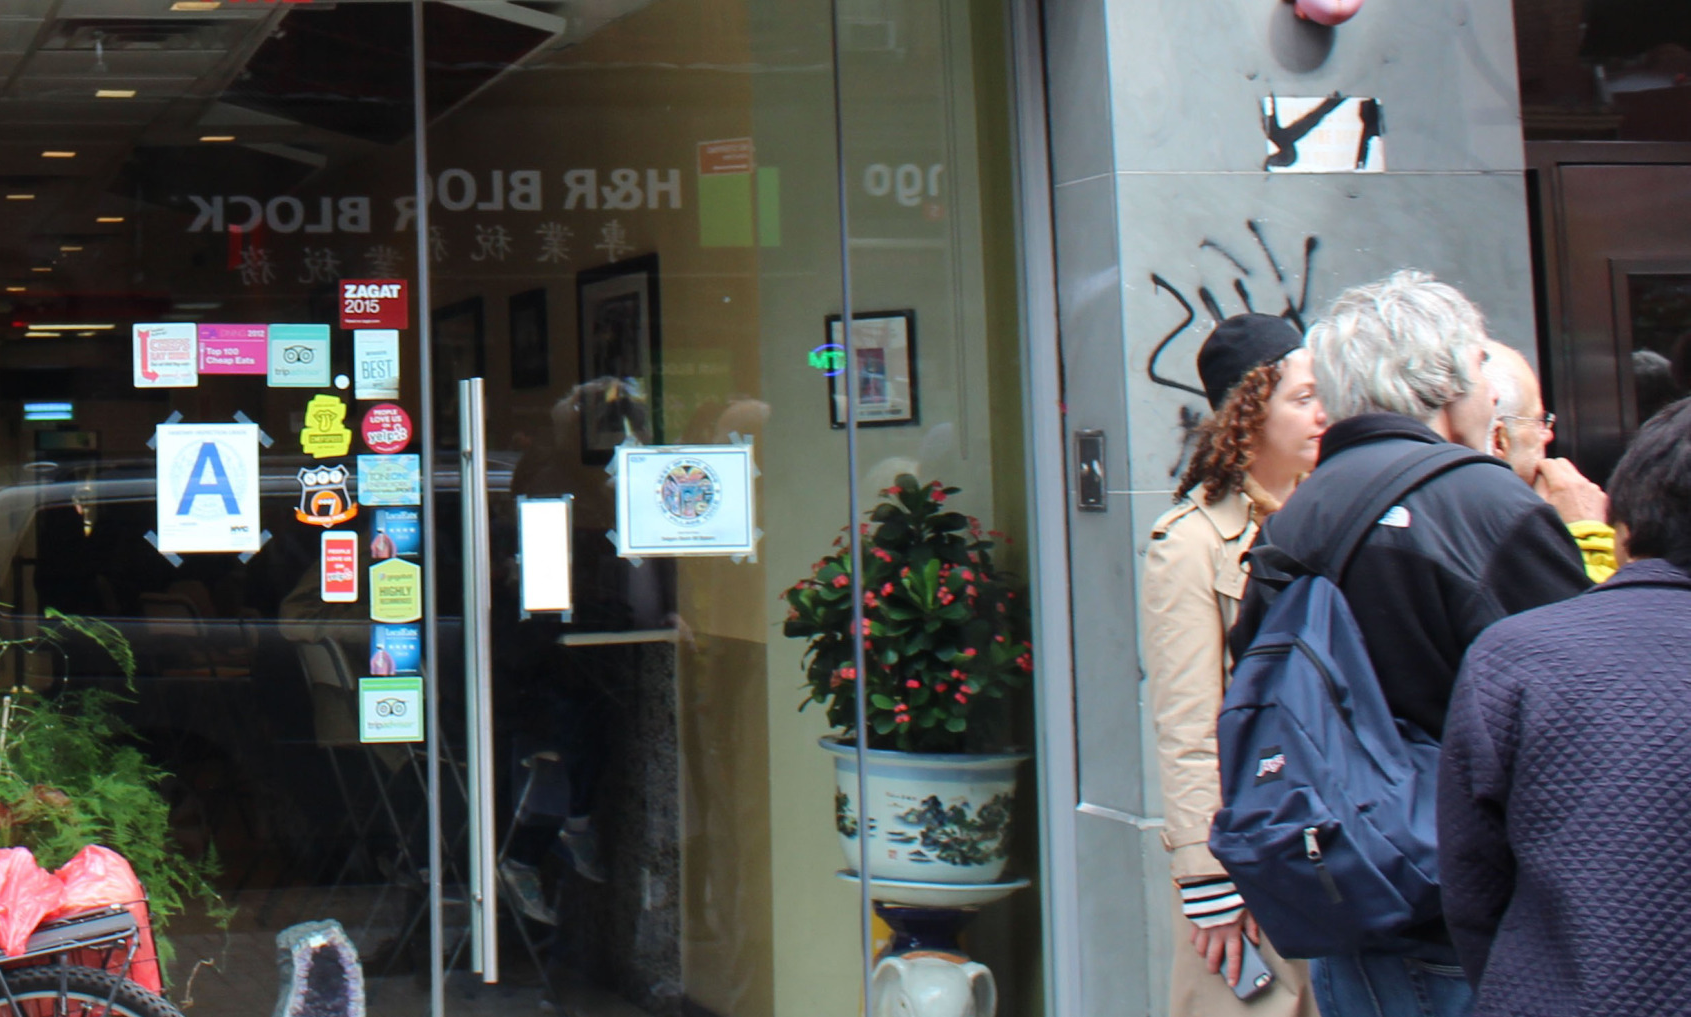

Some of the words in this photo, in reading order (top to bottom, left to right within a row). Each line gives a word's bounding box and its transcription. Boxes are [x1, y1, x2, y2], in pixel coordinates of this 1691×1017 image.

[343, 284, 402, 299] ZAGAT
[344, 299, 381, 314] 2015
[205, 347, 222, 357] Top
[223, 347, 239, 356] 100
[205, 356, 234, 366] Cheap
[234, 356, 255, 365] Eats
[361, 358, 393, 380] BEST
[369, 416, 390, 424] LOVE
[391, 415, 402, 423] US
[367, 429, 395, 445] yelp
[175, 441, 242, 516] A
